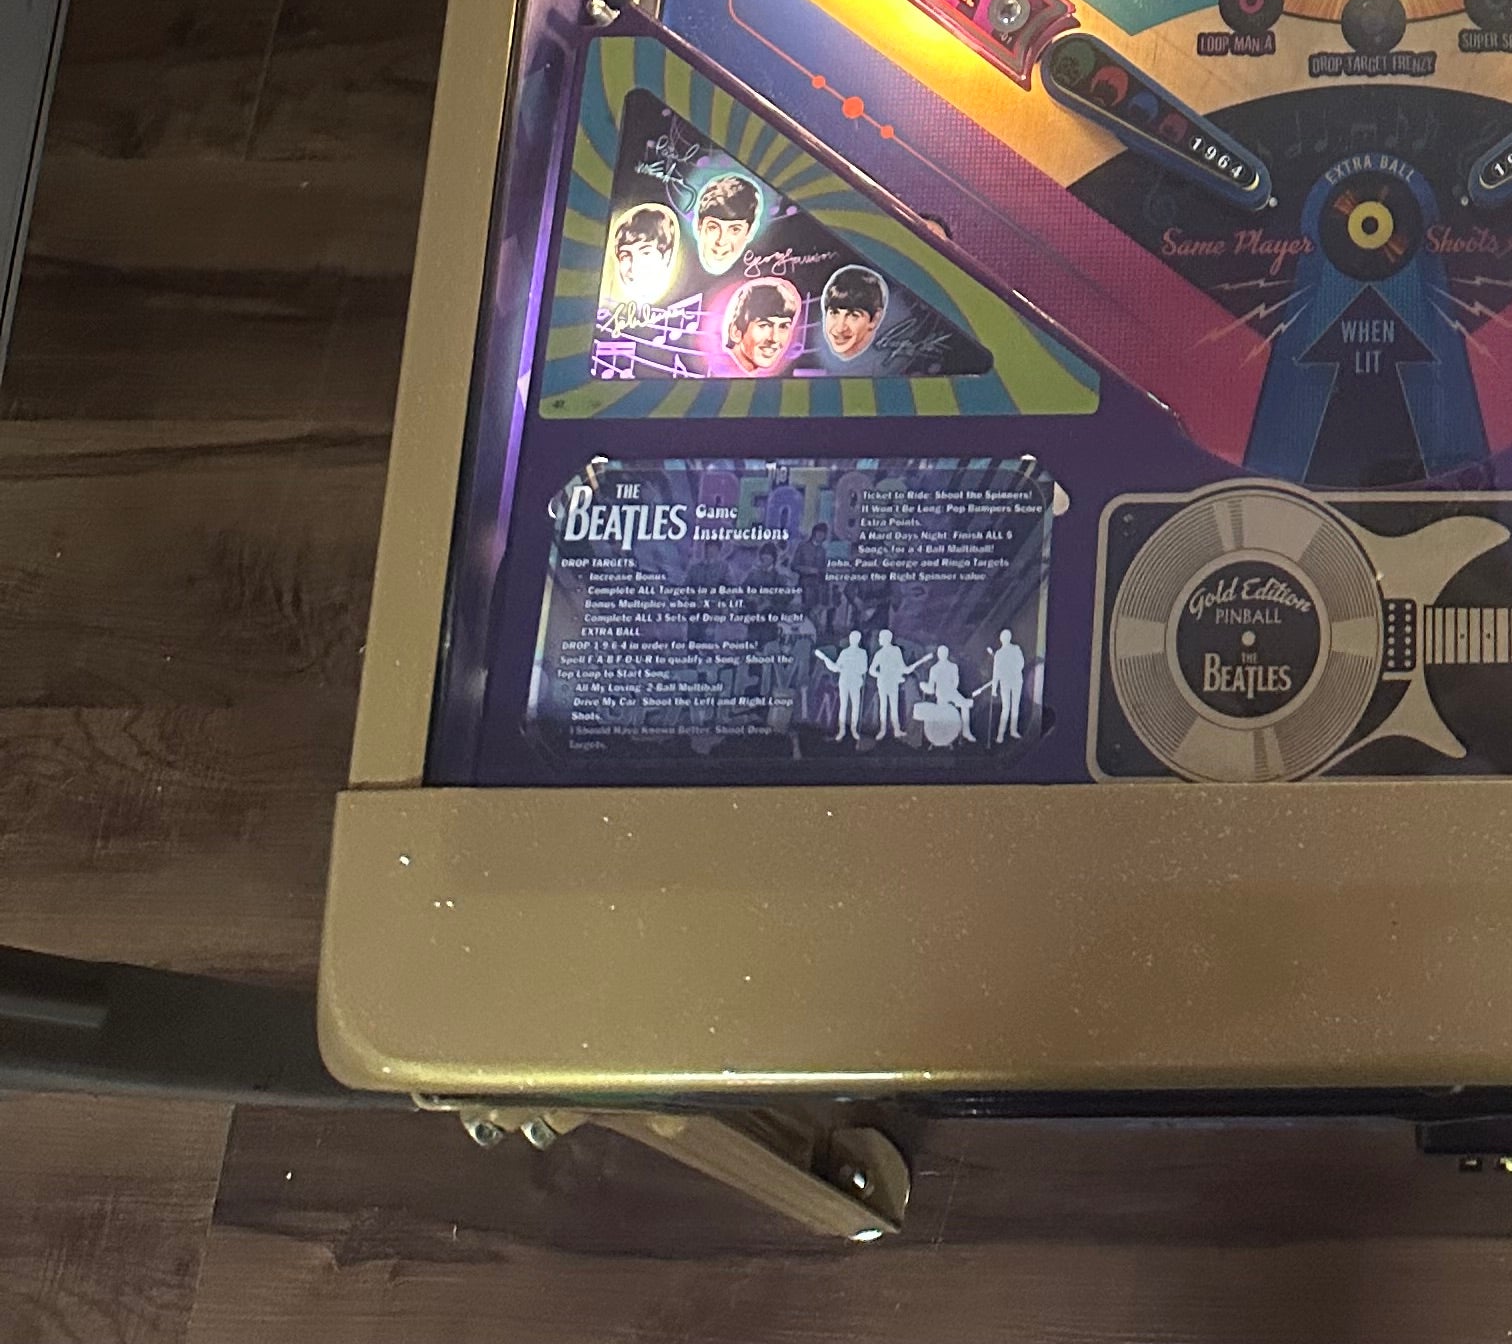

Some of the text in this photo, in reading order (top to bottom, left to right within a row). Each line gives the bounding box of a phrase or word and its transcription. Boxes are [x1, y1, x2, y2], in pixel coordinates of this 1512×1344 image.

[1325, 155, 1415, 184] EXTRA BALL
[1162, 227, 1226, 256] Same
[1233, 225, 1314, 275] Player
[1426, 223, 1498, 254] Shoots
[1341, 320, 1395, 343] WHEN
[1355, 352, 1381, 373] LIT
[616, 484, 641, 499] THE
[564, 485, 737, 551] BEATLES Game
[693, 525, 789, 540] Instructions
[1189, 576, 1311, 620] Gold Edition
[1215, 608, 1282, 625] PINBALL
[1241, 653, 1258, 663] THE
[1203, 653, 1291, 699] BEATLES
